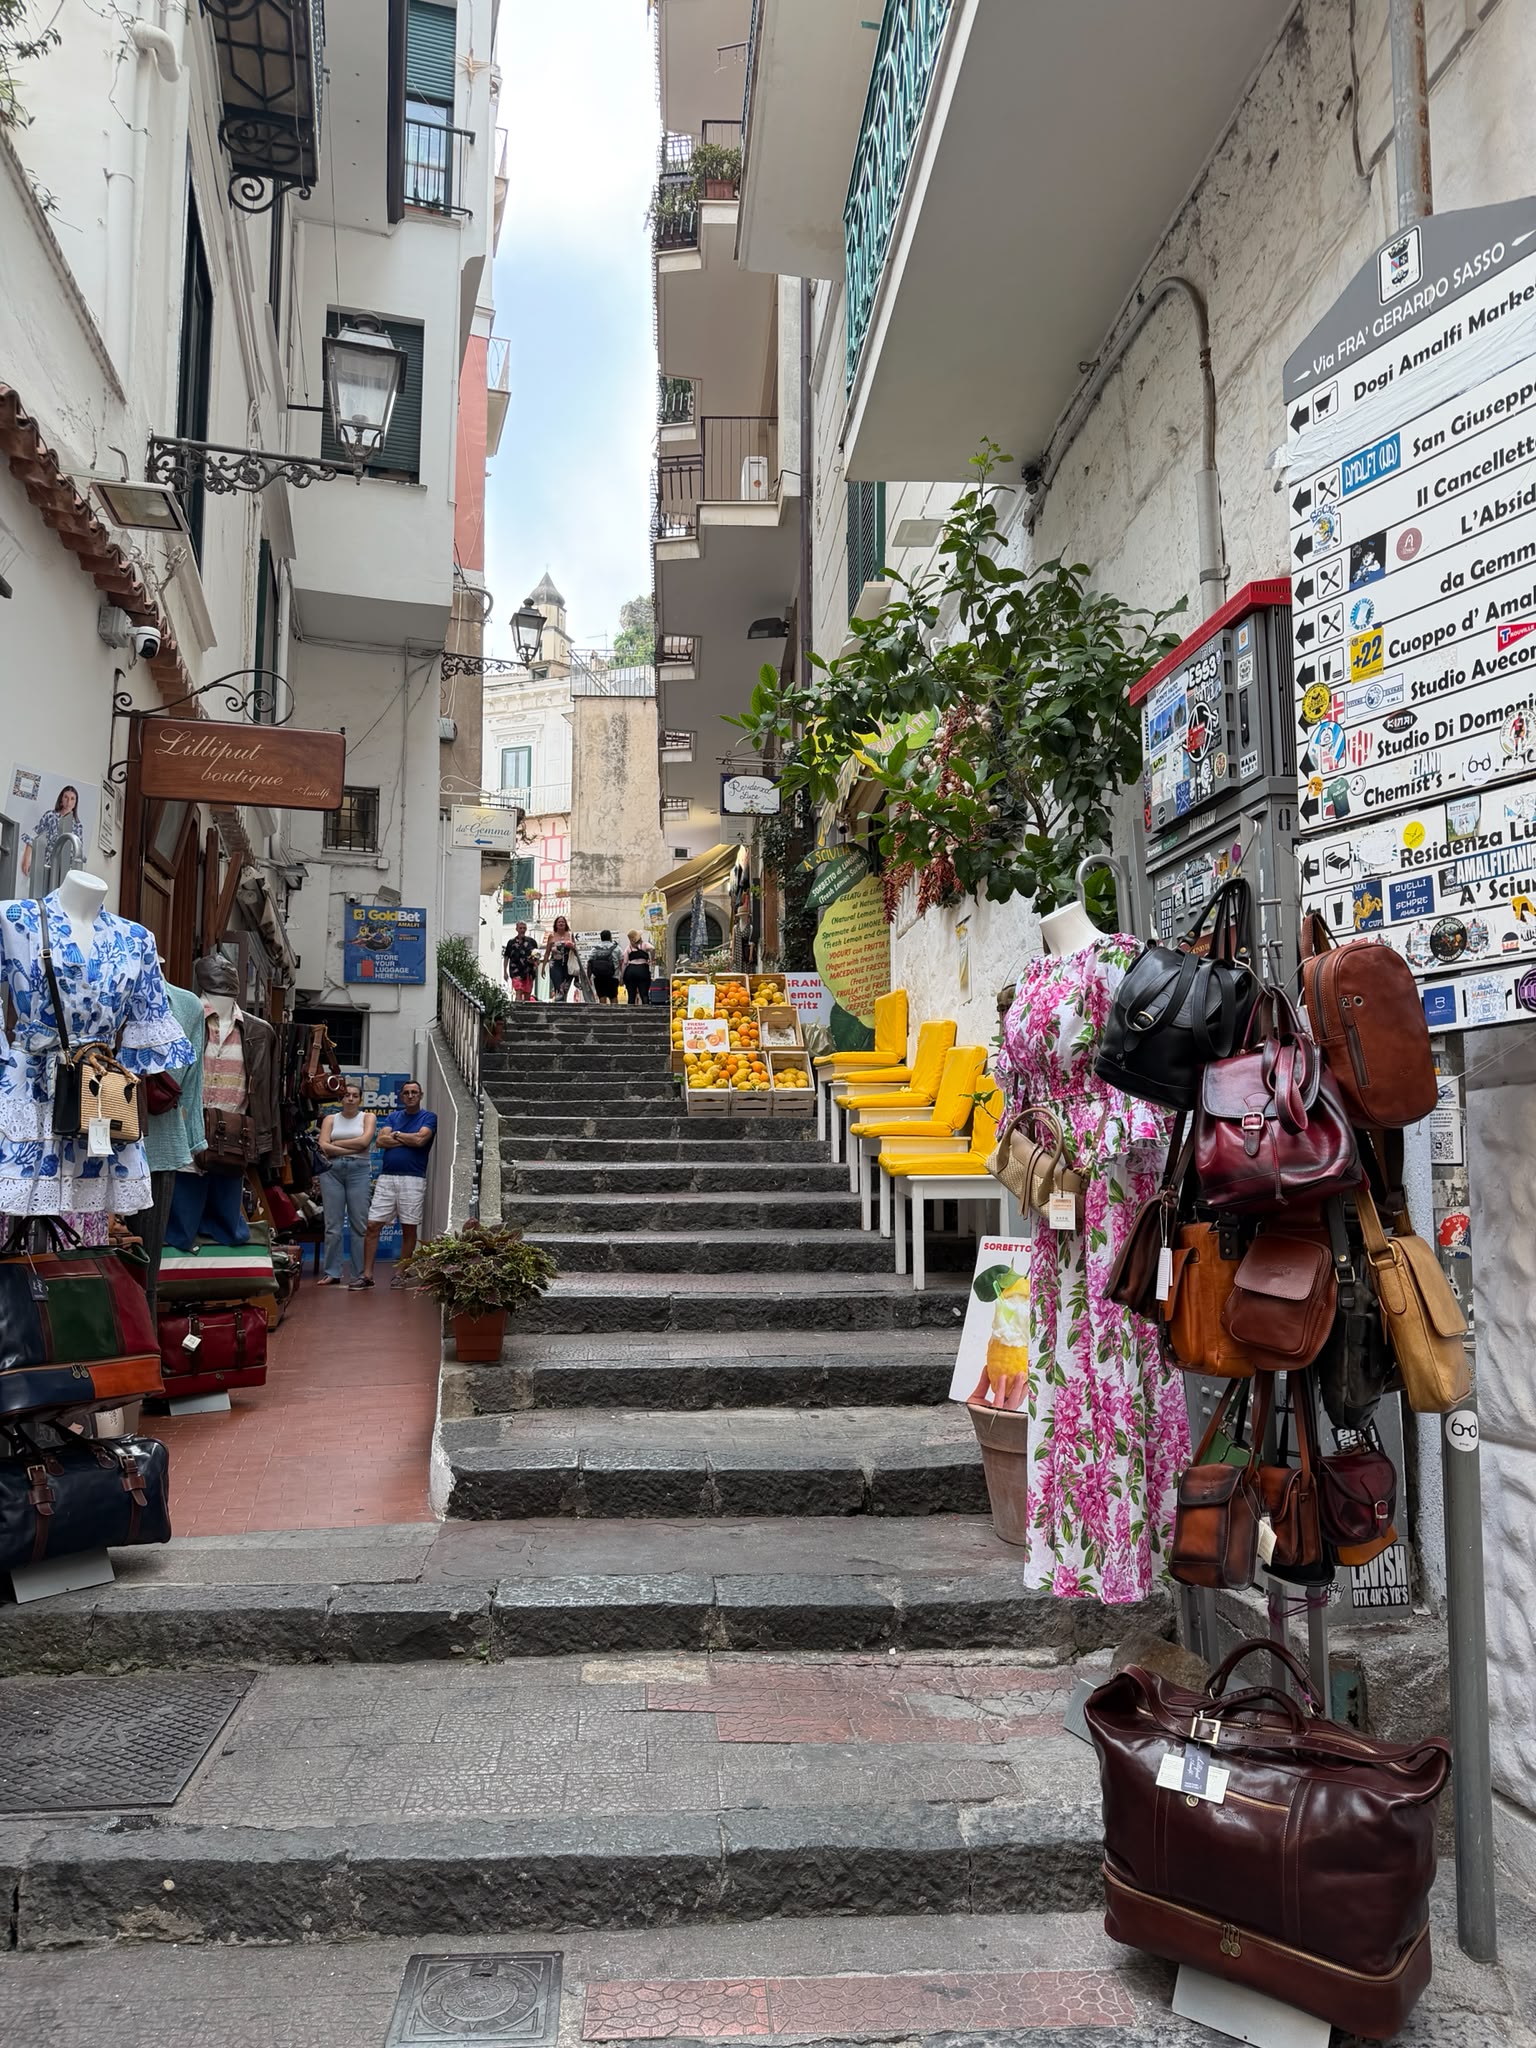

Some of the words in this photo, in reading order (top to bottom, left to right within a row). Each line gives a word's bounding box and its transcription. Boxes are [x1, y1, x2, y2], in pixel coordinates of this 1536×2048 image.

[1312, 352, 1335, 376] Via
[1372, 276, 1449, 338] GERARDO
[1452, 241, 1506, 289] SASSO
[1353, 364, 1394, 402] Dogi
[1398, 323, 1463, 377] Amalfi
[1412, 431, 1446, 458] San
[1416, 489, 1429, 508] Il
[1433, 436, 1536, 498] Cancellett
[1440, 571, 1465, 594] da
[1388, 622, 1456, 660] Cuoppo
[1461, 607, 1480, 632] d'
[1410, 667, 1467, 702] Studio
[1377, 729, 1430, 760] Studio
[1434, 718, 1454, 742] Di
[1459, 692, 1536, 734] Domeni
[154, 727, 265, 772] Lilliput
[200, 766, 285, 792] boutique
[728, 779, 772, 797] Residenza
[292, 786, 331, 800] Amalfi
[1363, 773, 1443, 808] Chemist's
[465, 823, 512, 839] Gemma
[1400, 829, 1503, 869] Residenza
[812, 873, 838, 898] SORBETTO
[833, 874, 851, 892] Lemon
[839, 890, 861, 903] GELATO
[368, 909, 421, 923] GoldBet
[857, 910, 877, 920] Lemon
[857, 919, 882, 931] LIMONE
[843, 934, 863, 945] Lemon
[863, 931, 876, 940] and
[829, 948, 852, 960] YOGURT
[864, 940, 886, 952] FRUTTA
[846, 957, 859, 967] with
[829, 966, 865, 980] MACEDONIE
[870, 972, 883, 981] Fruit
[787, 979, 822, 988] GRANI
[789, 991, 823, 1000] emon
[983, 1242, 1032, 1254] SORBETTO
[1351, 1544, 1408, 1588] LAVISH
